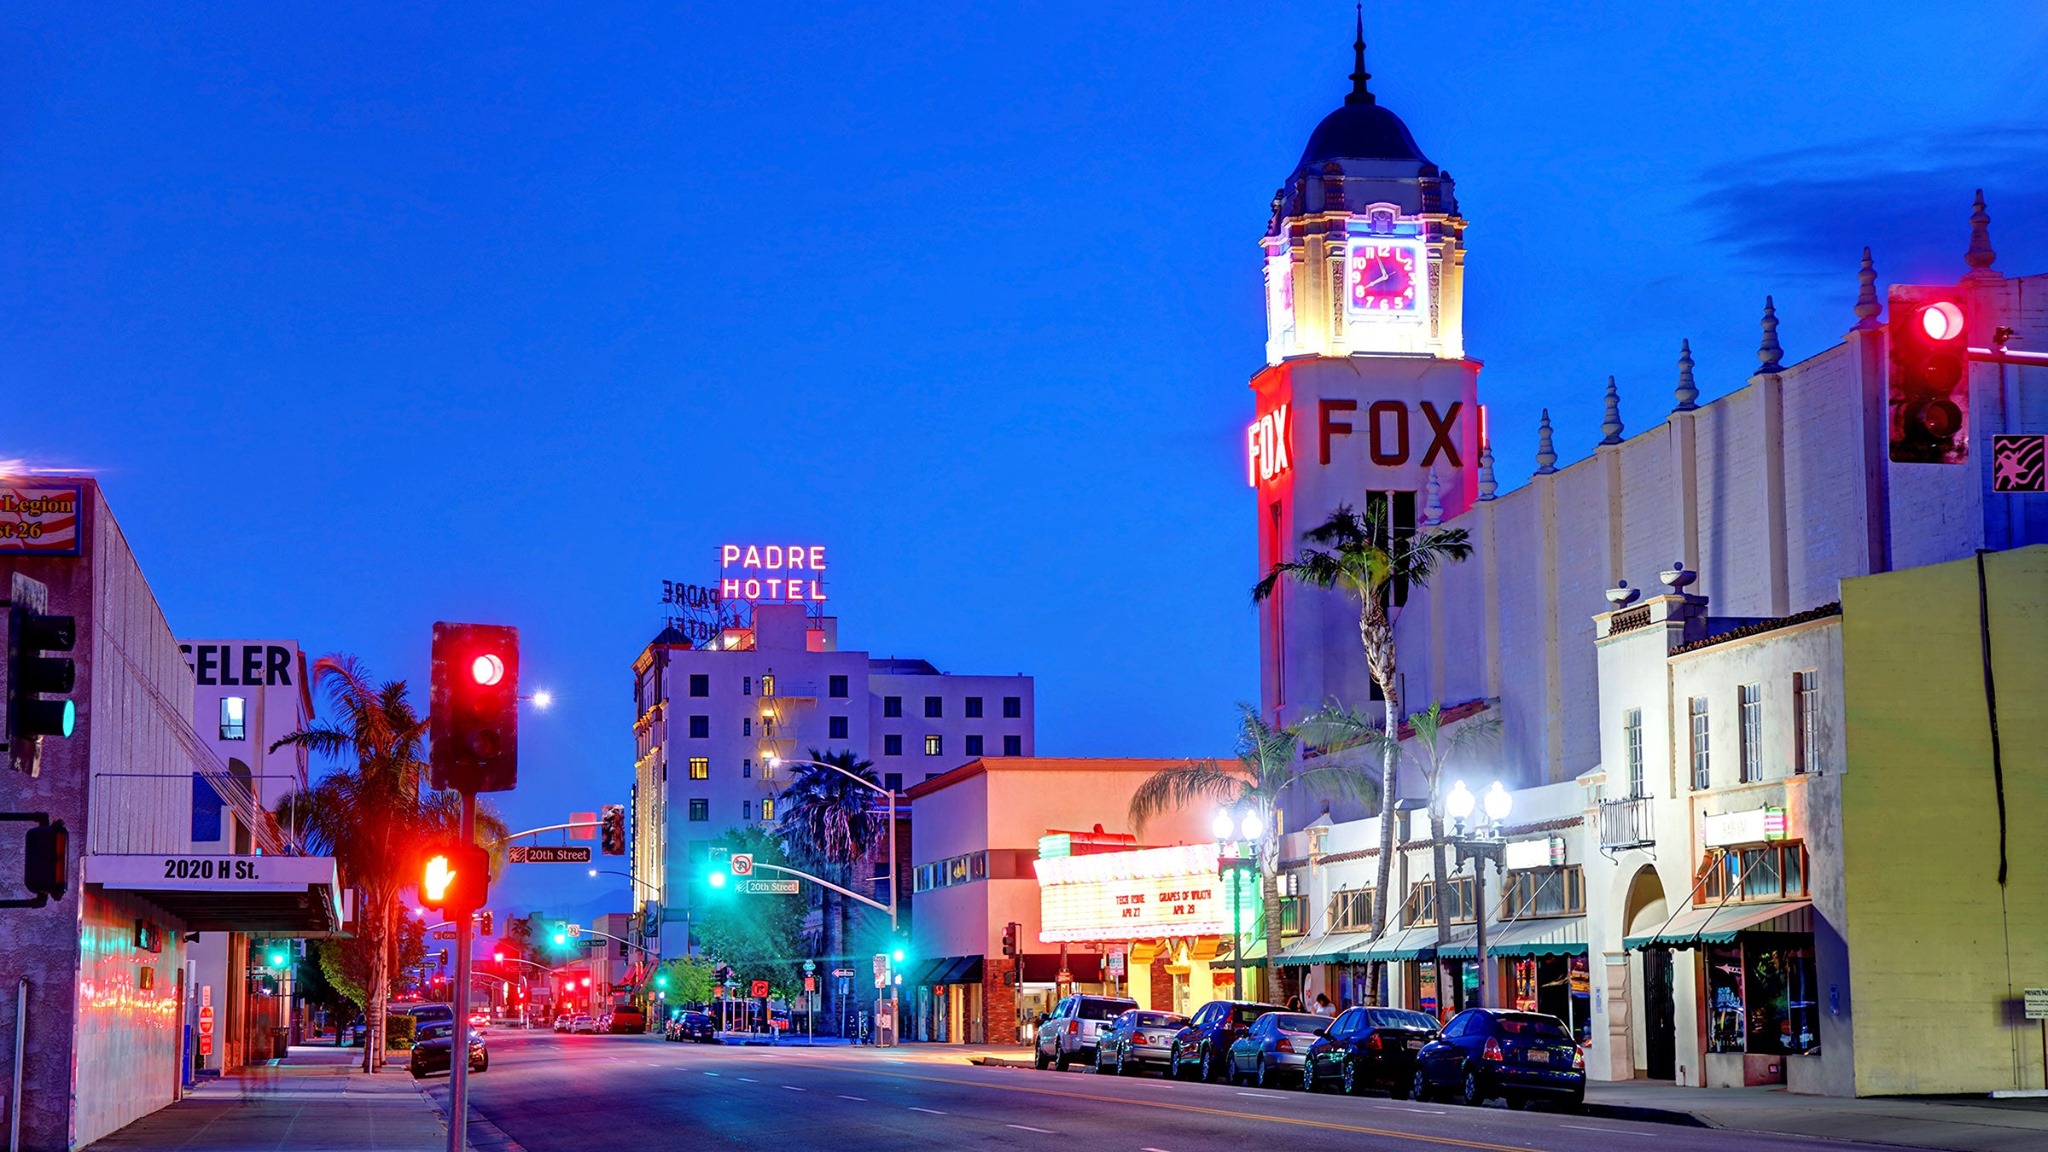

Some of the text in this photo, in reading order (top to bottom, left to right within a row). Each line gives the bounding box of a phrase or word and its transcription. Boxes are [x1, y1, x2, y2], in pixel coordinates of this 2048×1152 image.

[1377, 245, 1390, 257] 12
[1353, 257, 1366, 269] 10
[1403, 258, 1413, 270] 2
[1352, 271, 1361, 284] 9
[1408, 272, 1416, 285] 3
[1355, 285, 1365, 298] 8
[1403, 287, 1413, 299] 4
[1366, 296, 1374, 308] 7
[1380, 299, 1389, 311] 6
[1394, 297, 1403, 309] 5
[1318, 399, 1464, 467] FOX
[1248, 404, 1289, 488] FOX
[2, 495, 73, 517] Legion
[16, 521, 42, 539] 26
[723, 545, 826, 569] PADRE
[723, 578, 826, 600] HOTEL
[529, 850, 587, 860] 20th Street
[164, 859, 259, 879] 2020 H St.
[750, 882, 795, 891] 20th Street
[1182, 890, 1190, 901] OF
[1122, 907, 1141, 917] APR 27
[1173, 905, 1185, 915] APR
